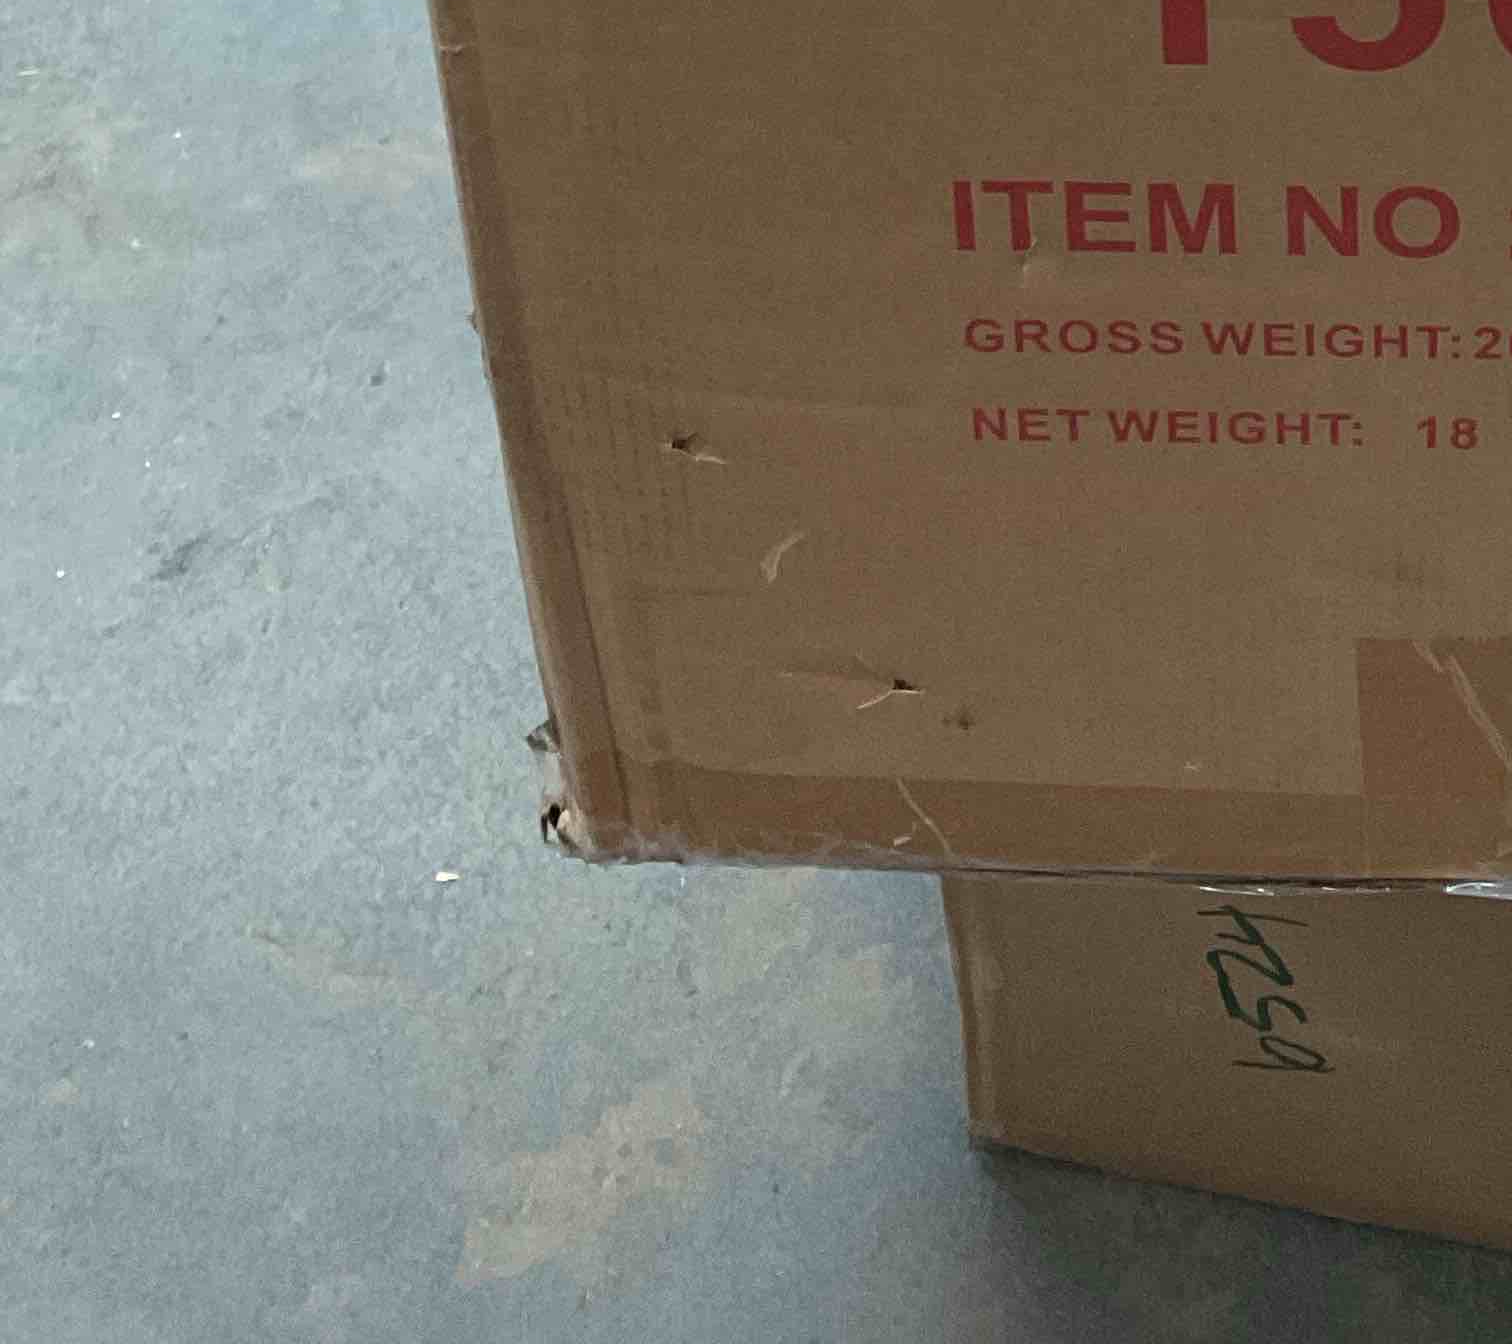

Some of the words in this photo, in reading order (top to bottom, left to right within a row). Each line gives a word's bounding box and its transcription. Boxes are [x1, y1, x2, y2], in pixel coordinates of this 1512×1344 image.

[950, 178, 1239, 256] ITEM
[1286, 184, 1461, 259] NO
[963, 318, 1184, 357] GROSS
[972, 407, 1090, 445] NET
[1107, 408, 1366, 450] WEIGHT:
[1417, 416, 1479, 452] 18
